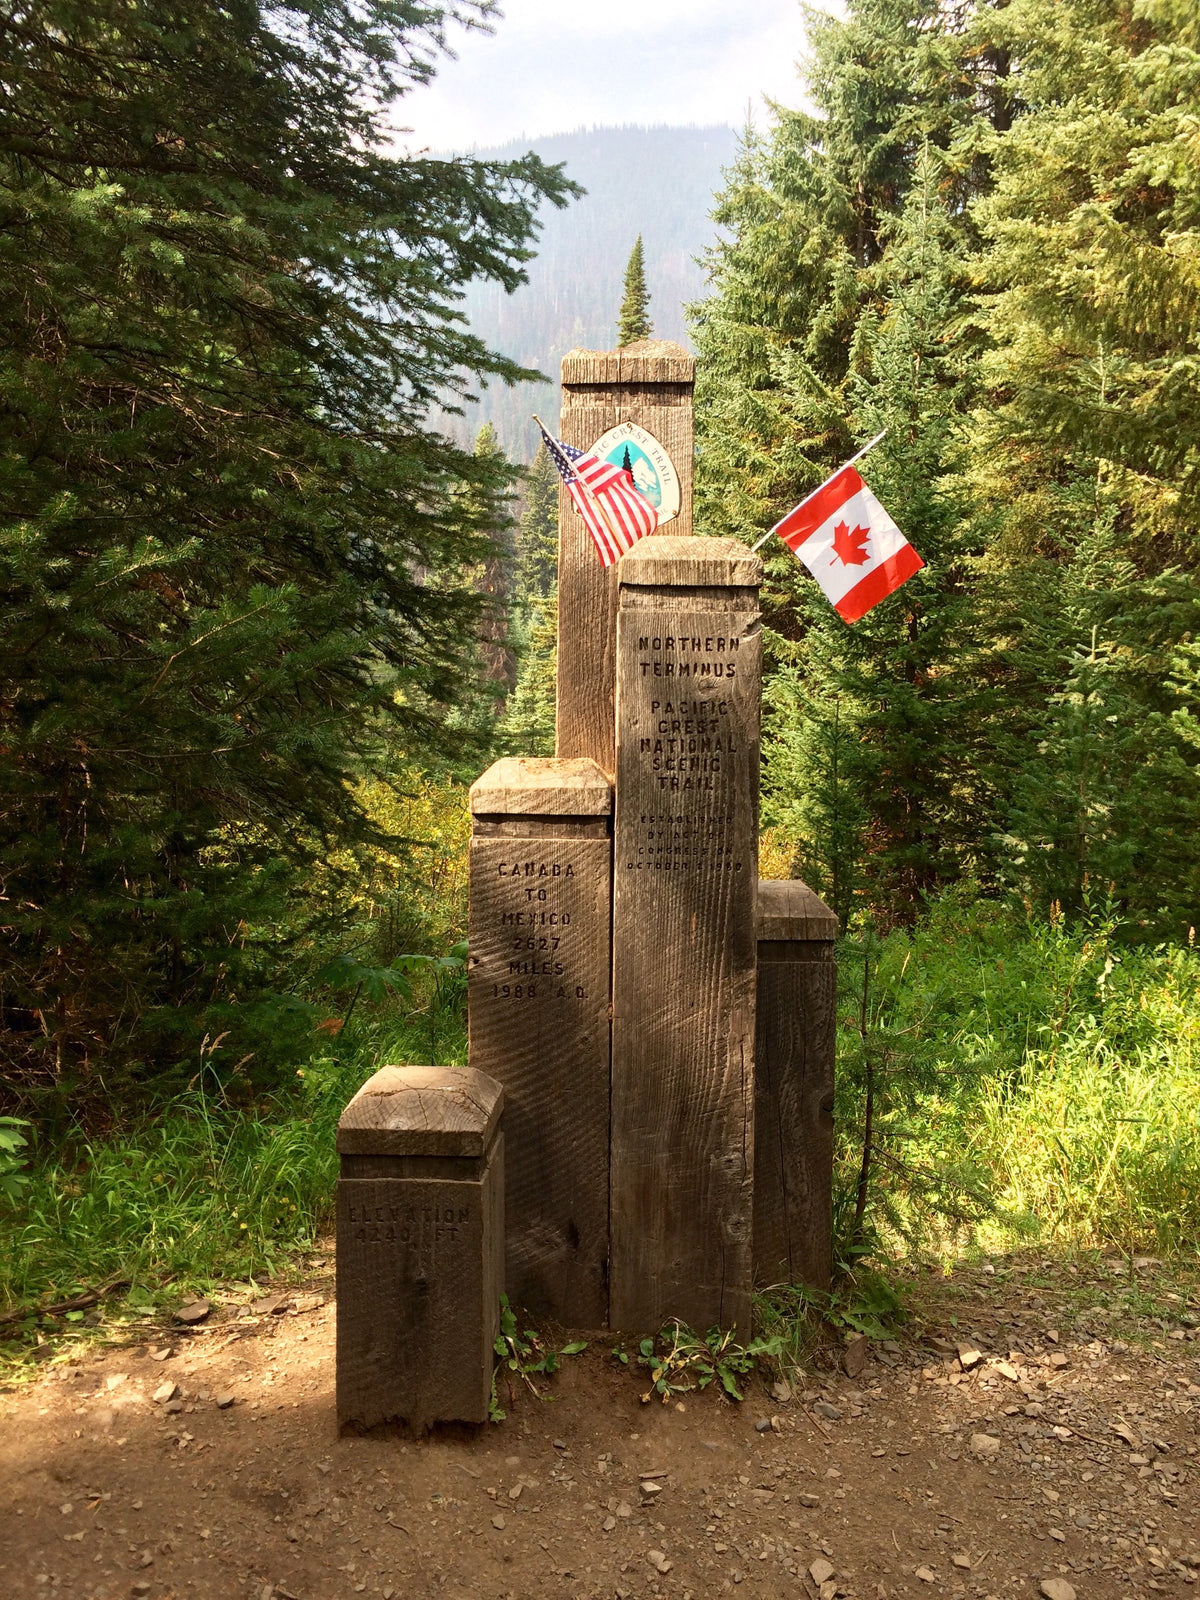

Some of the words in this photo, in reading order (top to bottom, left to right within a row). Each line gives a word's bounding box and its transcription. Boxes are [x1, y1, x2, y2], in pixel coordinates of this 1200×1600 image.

[652, 448, 672, 486] TRAIL
[638, 637, 740, 651] NORTHERN
[640, 663, 736, 678] TERMINUS
[651, 701, 729, 715] PACIFIC
[658, 720, 720, 734] CREST
[640, 737, 737, 753] NATIONAL
[653, 758, 721, 772] SCENIC
[657, 776, 714, 790] TRAIL
[640, 815, 733, 824] ESTABLISHED
[647, 831, 664, 840] BY
[673, 831, 699, 840] ACT
[638, 847, 710, 856] CONGRESS
[717, 847, 733, 856] ON
[498, 862, 575, 877] CANADA
[627, 862, 689, 871] OCTOBER
[525, 888, 547, 901] TO
[502, 912, 571, 926] MEXICO
[514, 938, 561, 951] 2627
[510, 962, 564, 975] MILES
[494, 986, 537, 998] 1988
[349, 1206, 470, 1222] ELEVATION
[357, 1227, 410, 1242] 4240
[436, 1227, 459, 1242] FT
